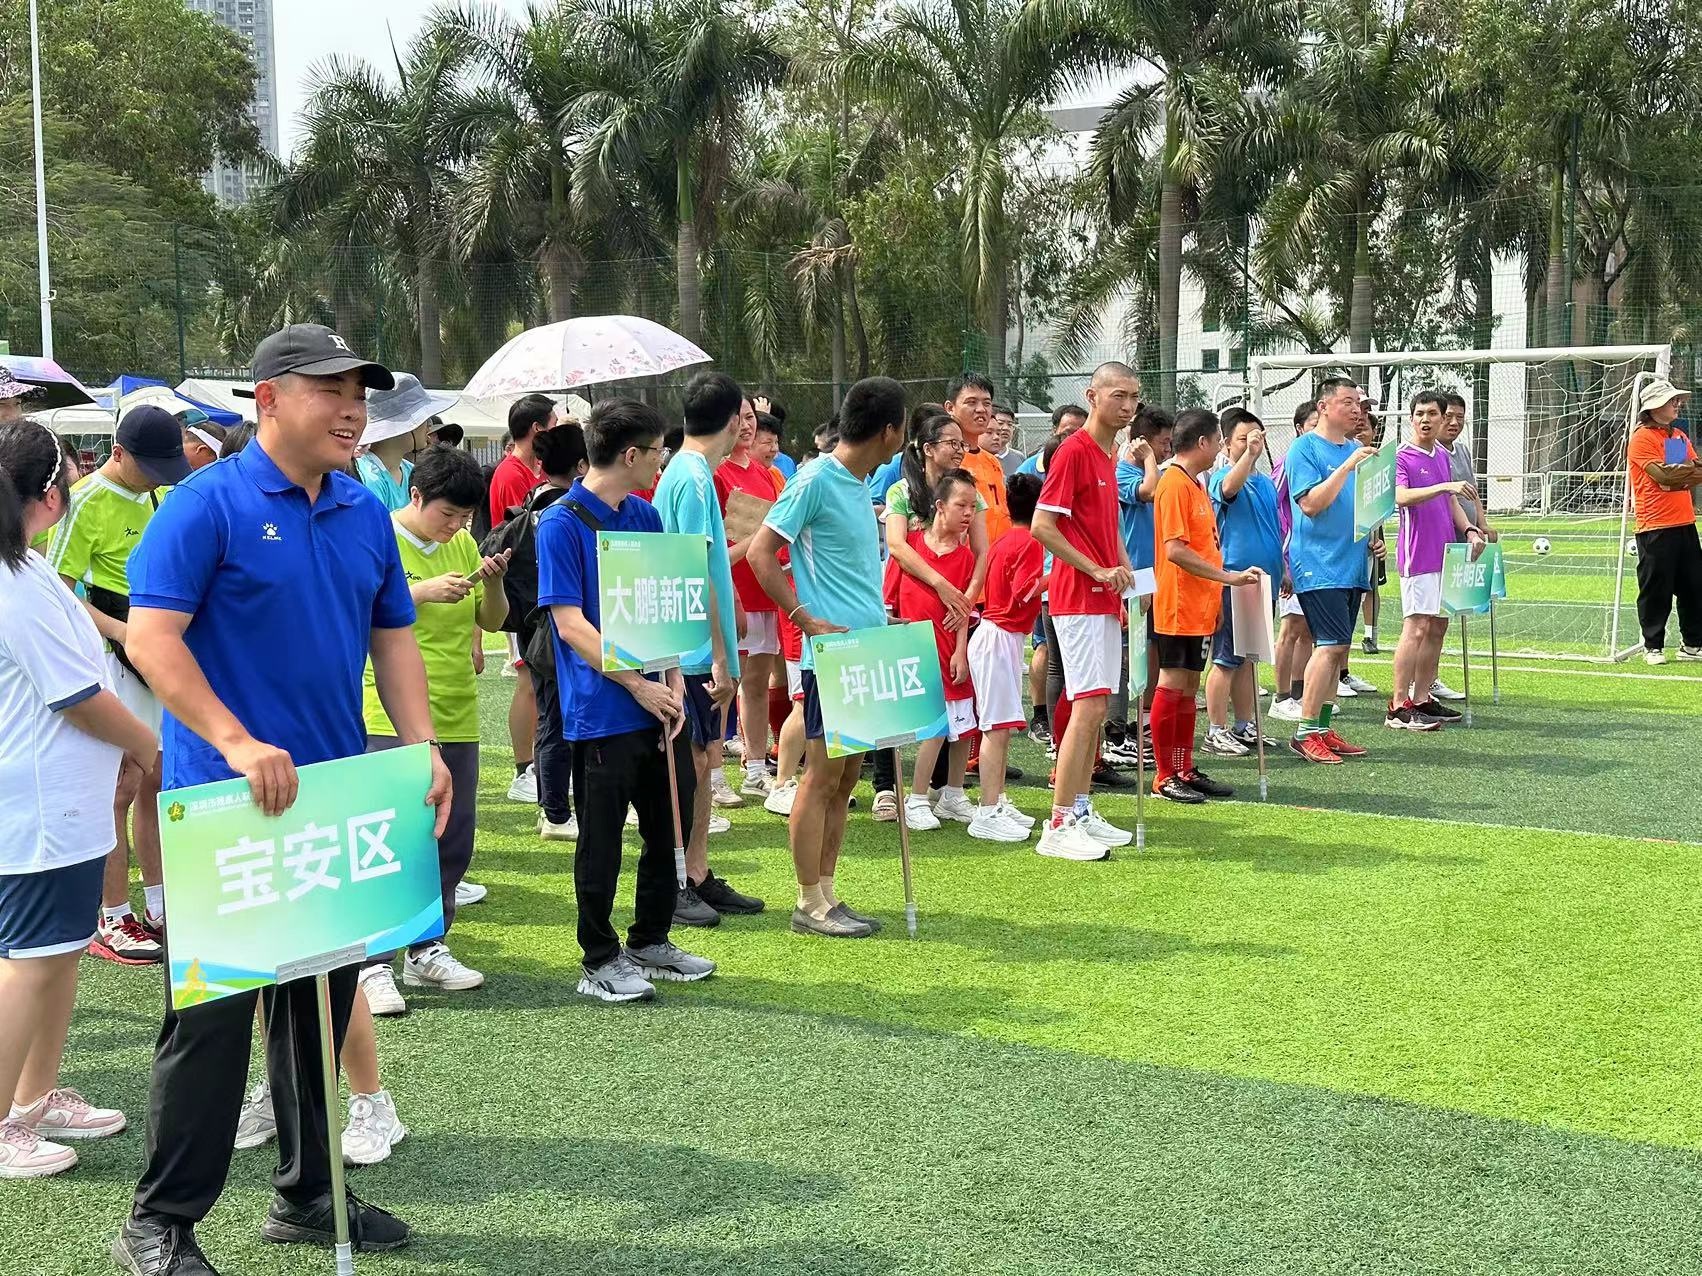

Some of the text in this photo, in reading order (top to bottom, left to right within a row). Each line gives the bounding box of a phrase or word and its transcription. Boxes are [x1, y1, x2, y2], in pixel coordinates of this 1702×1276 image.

[327, 334, 351, 352] R
[988, 483, 1000, 506] 7
[1450, 562, 1487, 588] 光明区
[607, 575, 708, 625] 大鹏新区
[1200, 635, 1211, 660] 5
[840, 655, 926, 707] 坪山区
[214, 807, 402, 915] 宝安区
